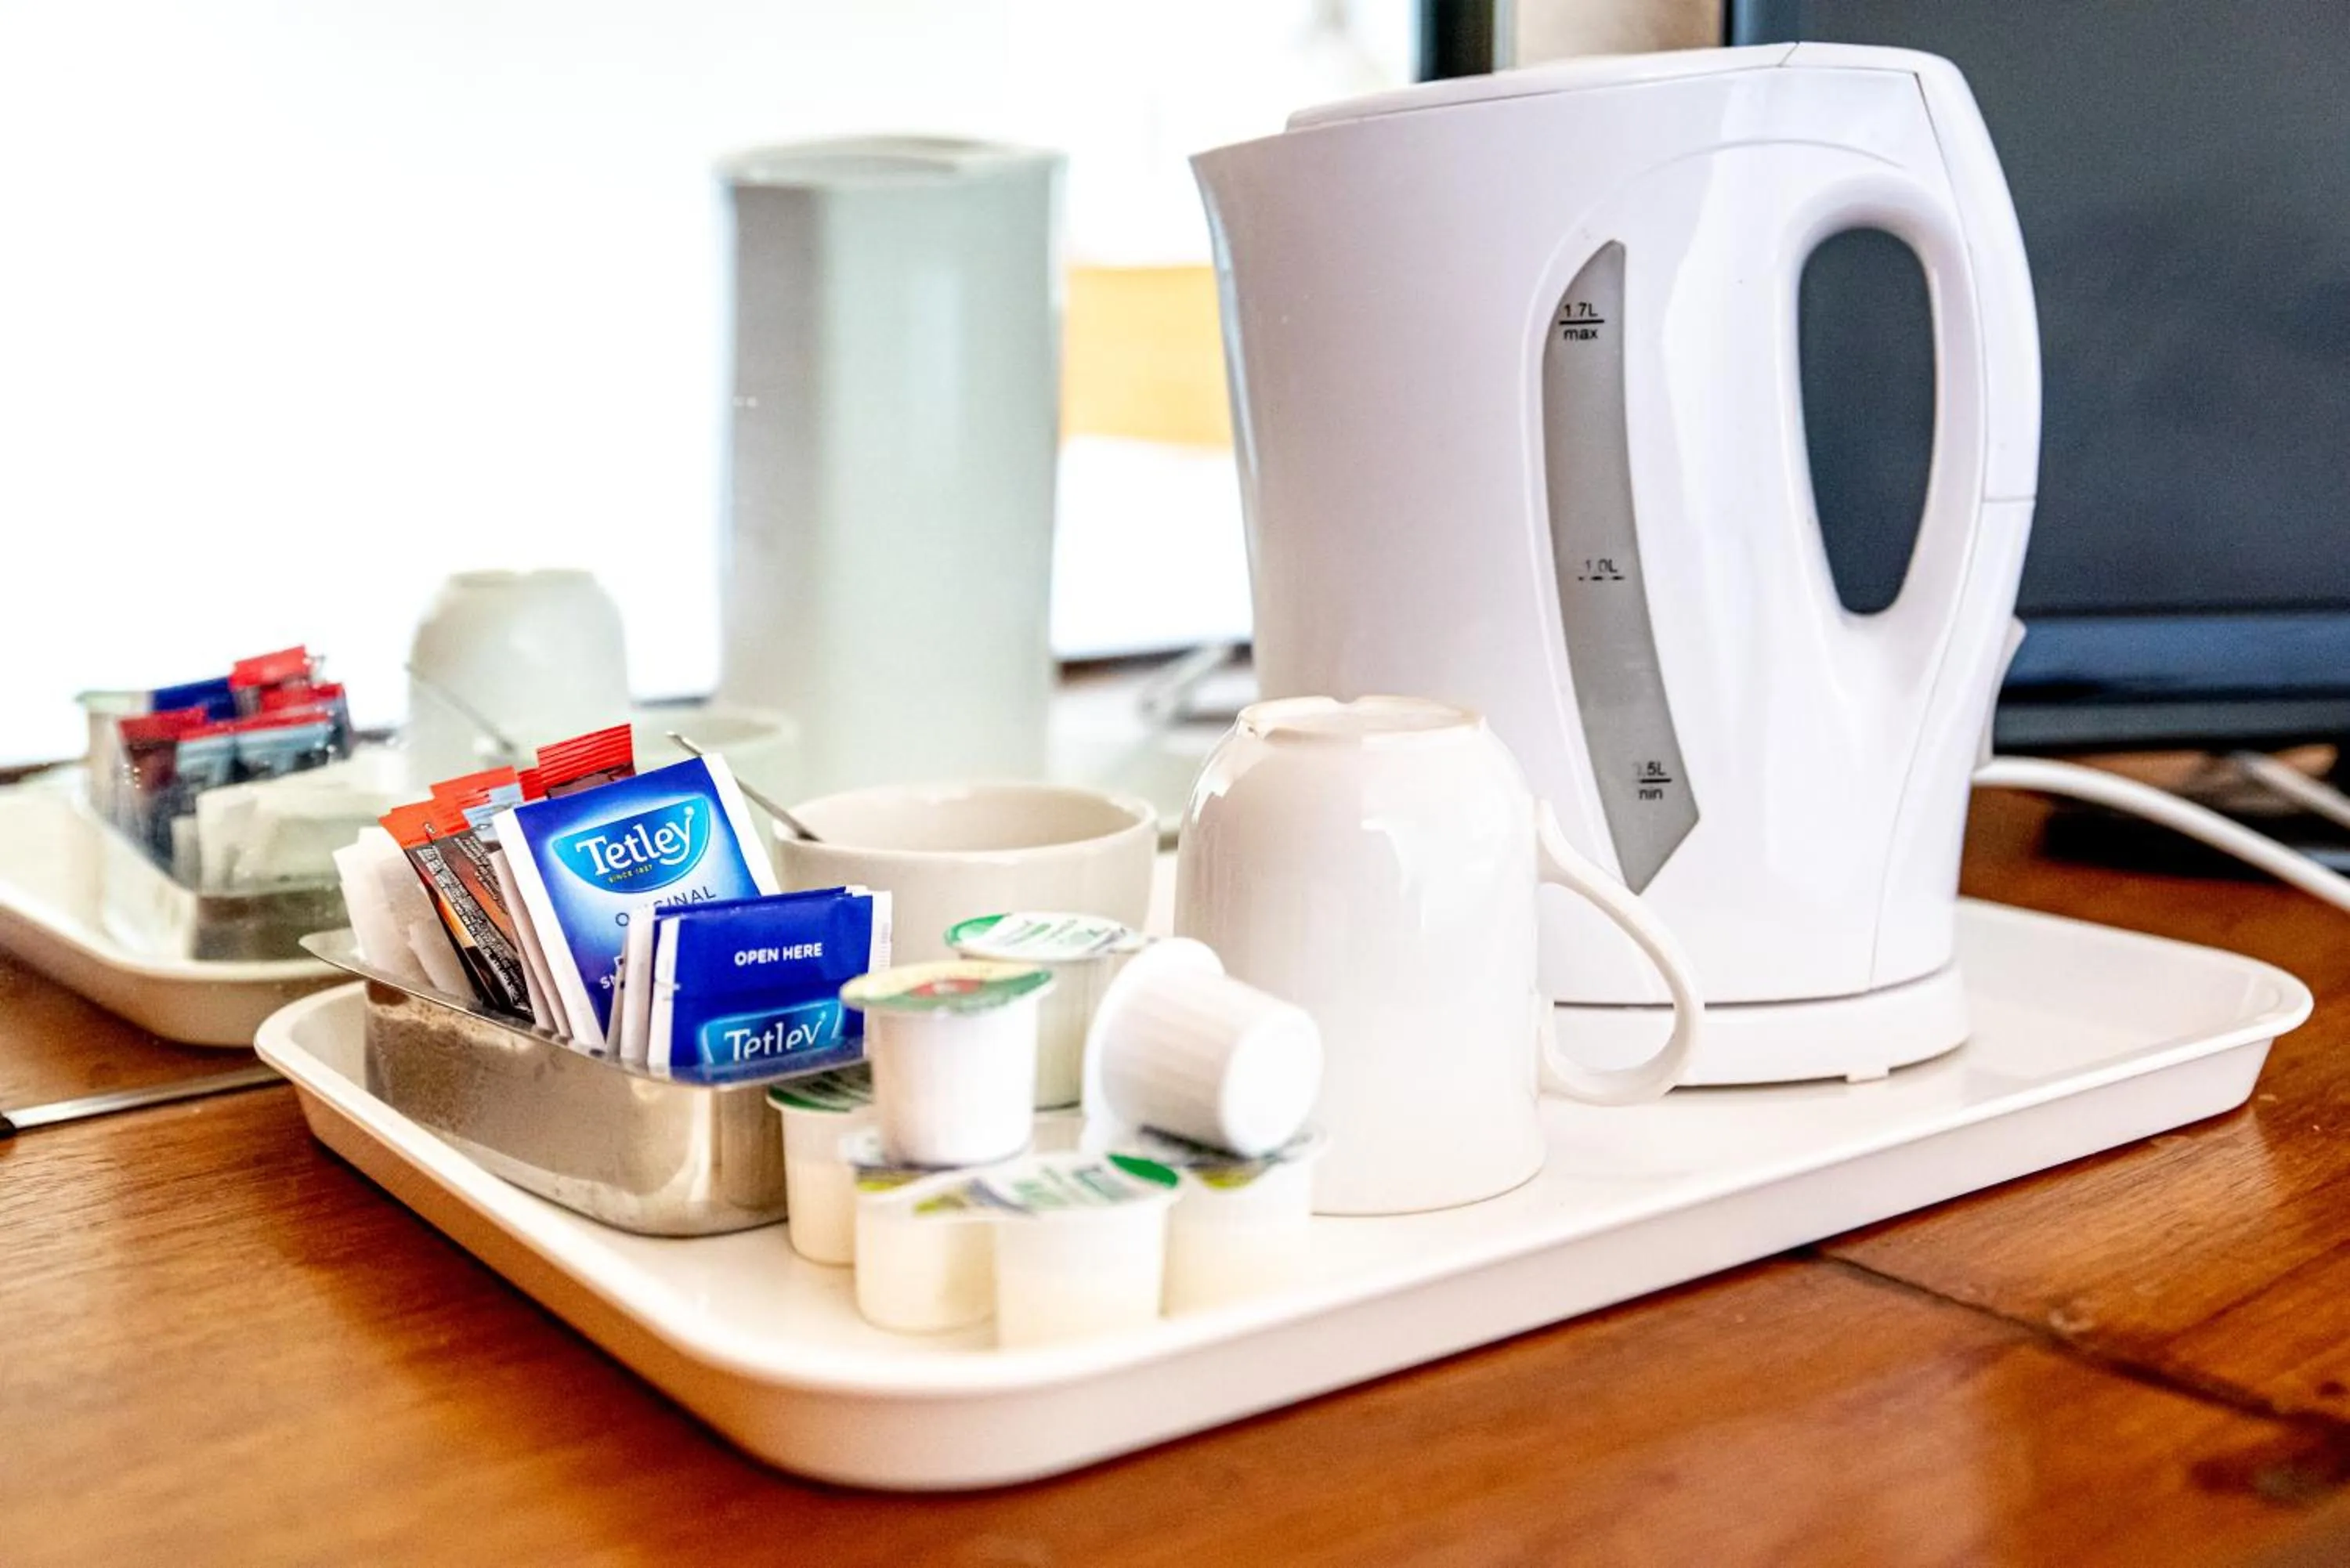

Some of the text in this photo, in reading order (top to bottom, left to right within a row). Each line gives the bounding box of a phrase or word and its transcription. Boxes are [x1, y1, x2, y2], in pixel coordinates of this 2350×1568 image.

[1564, 328, 1599, 341] max
[575, 806, 695, 876] Tetley
[608, 869, 633, 883] SINCE
[734, 942, 823, 966] OPEN HERE
